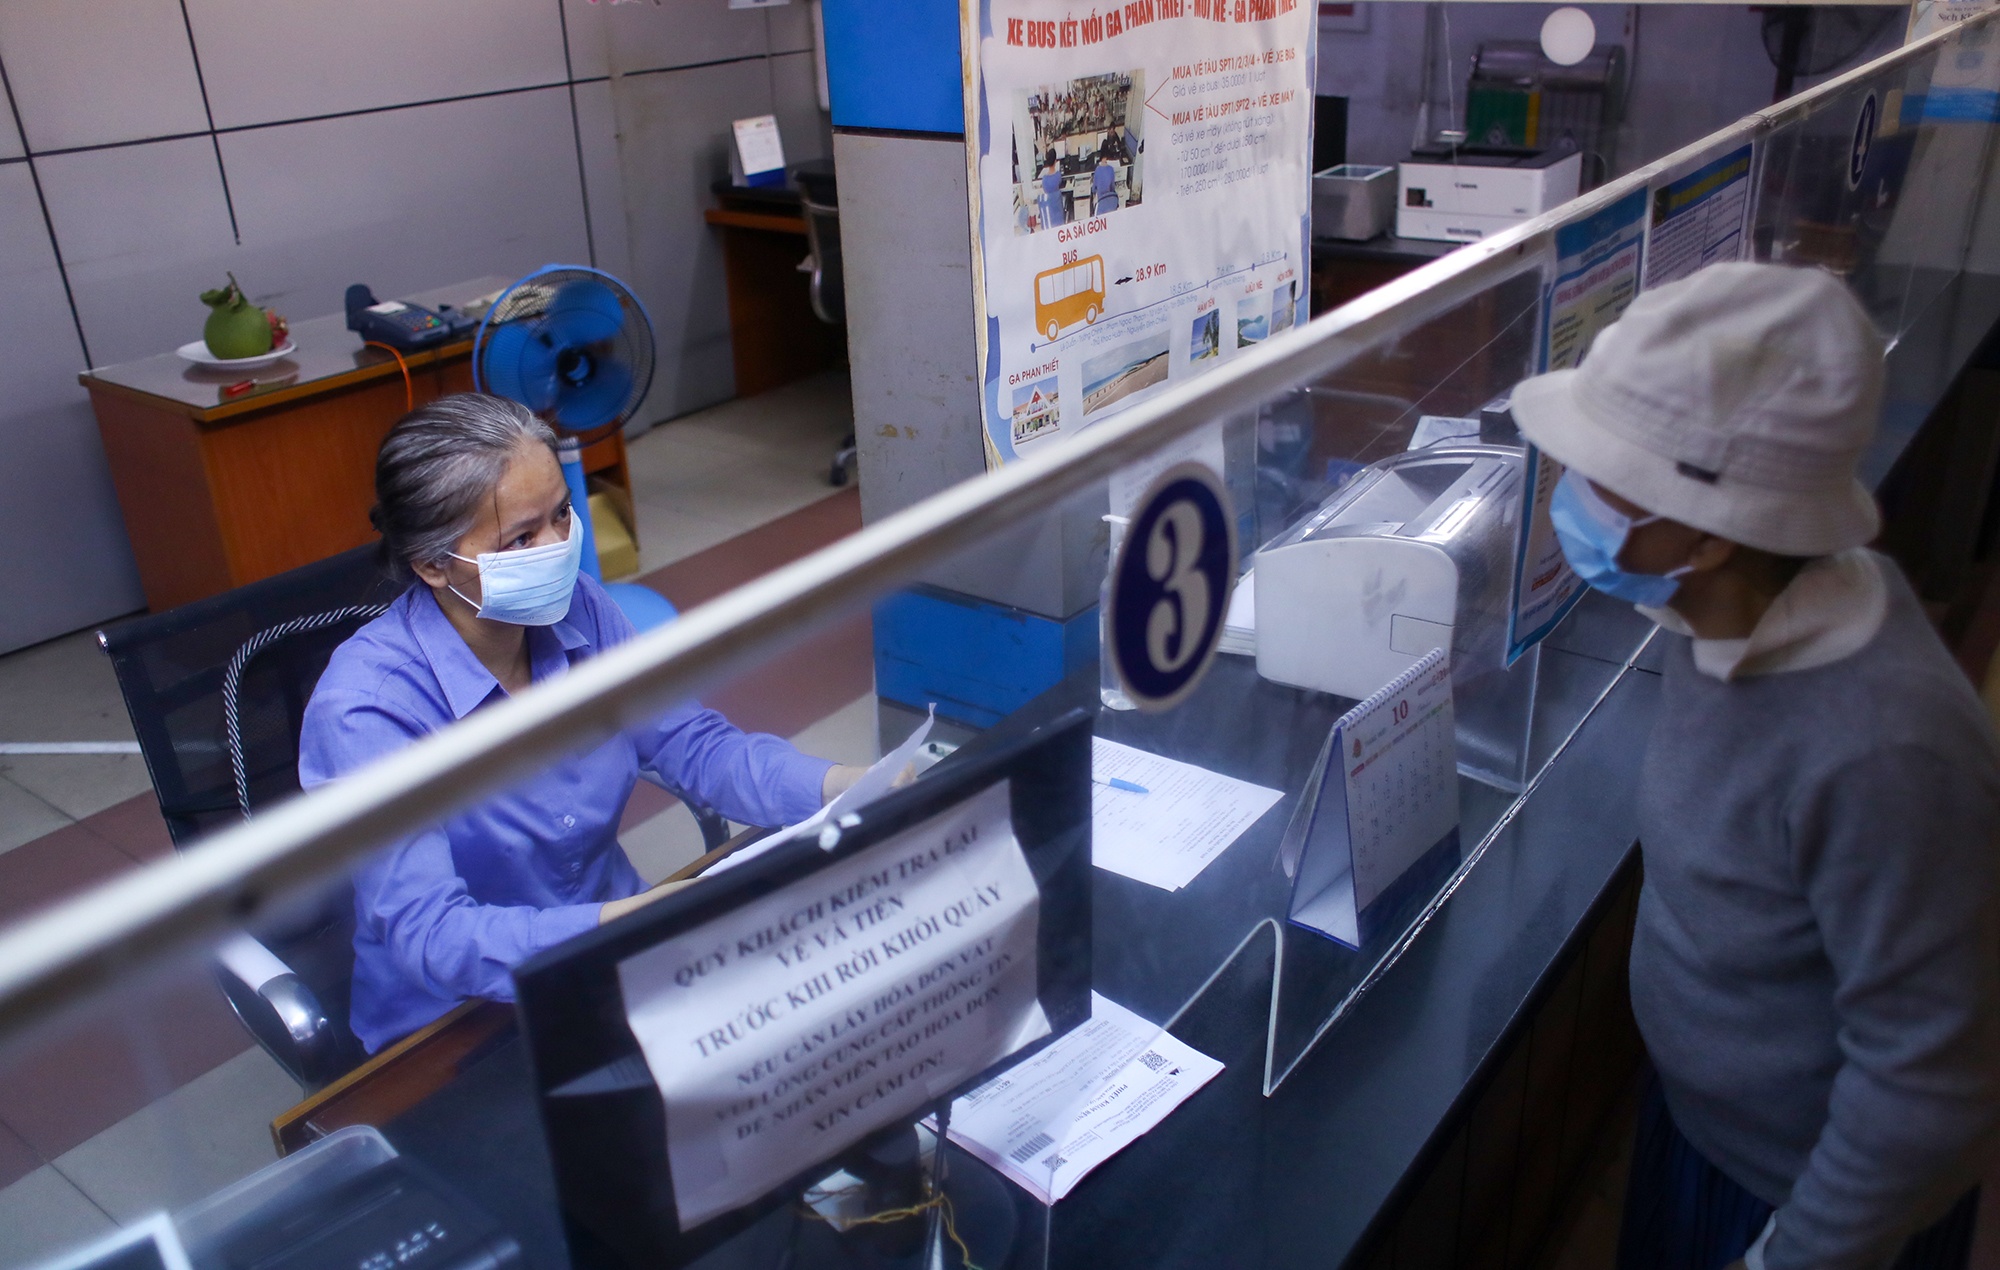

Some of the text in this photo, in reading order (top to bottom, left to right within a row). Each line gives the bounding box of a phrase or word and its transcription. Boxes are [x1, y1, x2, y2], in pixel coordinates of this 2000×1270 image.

[1007, 17, 1023, 46] XE
[1027, 20, 1056, 48] BUS
[1060, 12, 1078, 48] KẾT
[1081, 8, 1103, 45] NỐI
[1106, 9, 1122, 38] GA
[1125, 0, 1154, 30] PHAN
[1173, 65, 1191, 80] MUA
[1194, 57, 1203, 76] VÉ
[1205, 58, 1217, 74] TÀU
[1262, 48, 1274, 64] VÉ
[1276, 49, 1284, 63] XE
[1285, 47, 1295, 61] BUS
[1172, 83, 1186, 98] Giá
[1188, 82, 1197, 95] vé
[1199, 83, 1206, 93] xe
[1172, 111, 1190, 126] MUA
[1193, 105, 1204, 122] VÉ
[1205, 103, 1219, 119] TÀU
[1257, 92, 1268, 107] VÉ
[1269, 93, 1280, 107] XE
[1171, 132, 1184, 145] Giá
[1185, 130, 1194, 142] vé
[1195, 129, 1205, 140] xe
[1057, 217, 1107, 243] GA SÀI GÒN
[1062, 249, 1078, 265] BUS
[1136, 263, 1166, 282] 28.9 Km
[1009, 357, 1059, 385] GA PHAN THIẾT
[1147, 500, 1210, 674] 3
[1392, 699, 1408, 726] 10
[674, 826, 979, 987] QUÝ KHÁCH KIỂM TRA LẠI
[776, 891, 905, 969] VÉ VÀ TIỀN
[692, 881, 1003, 1059] TRƯỚC KHI RỜI KHỎI QUẦY
[821, 1034, 876, 1071] CUNG
[879, 1005, 916, 1040] CẤP
[920, 972, 982, 1014] THÔNG
[829, 1006, 869, 1039] LẤY
[873, 983, 914, 1015] HÓA
[832, 1057, 878, 1089] VIÊN
[924, 1009, 962, 1040] HÓA
[812, 1105, 850, 1133] XIN
